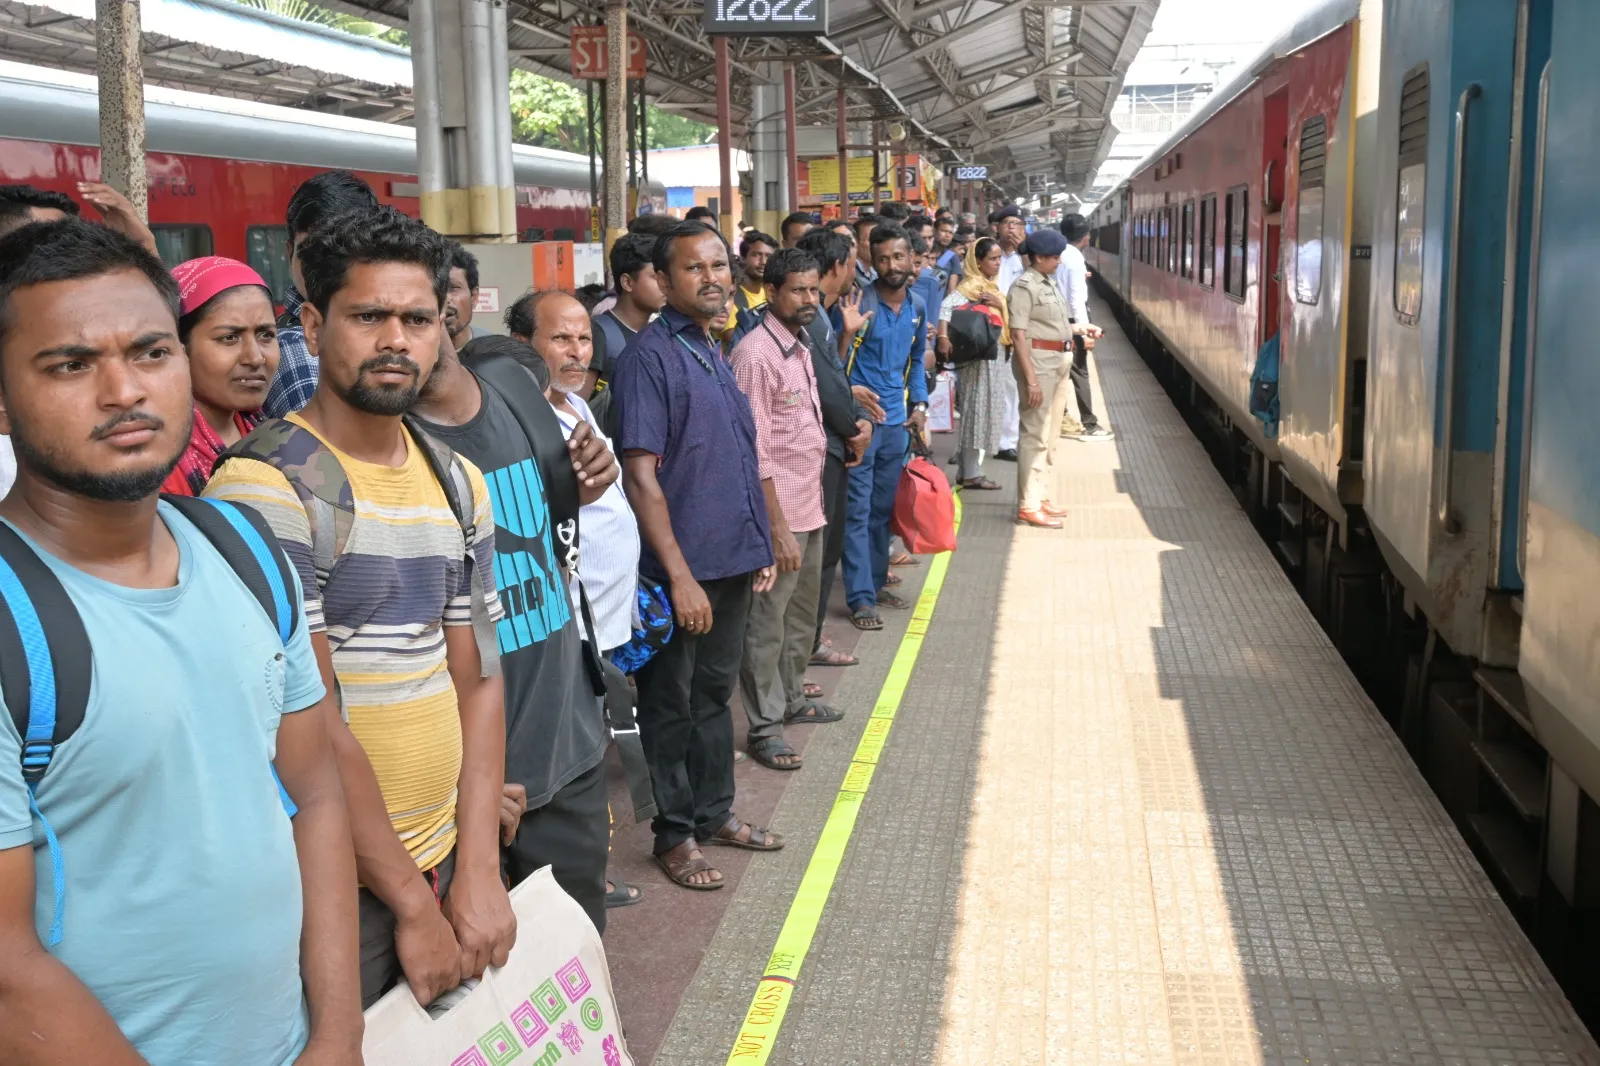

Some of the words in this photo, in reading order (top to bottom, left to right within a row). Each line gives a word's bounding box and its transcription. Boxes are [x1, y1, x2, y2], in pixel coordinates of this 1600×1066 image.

[576, 36, 641, 70] STP
[956, 166, 987, 180] 12822
[767, 952, 795, 972] RPF
[748, 985, 784, 1025] CROSS
[733, 1032, 766, 1058] NOT
